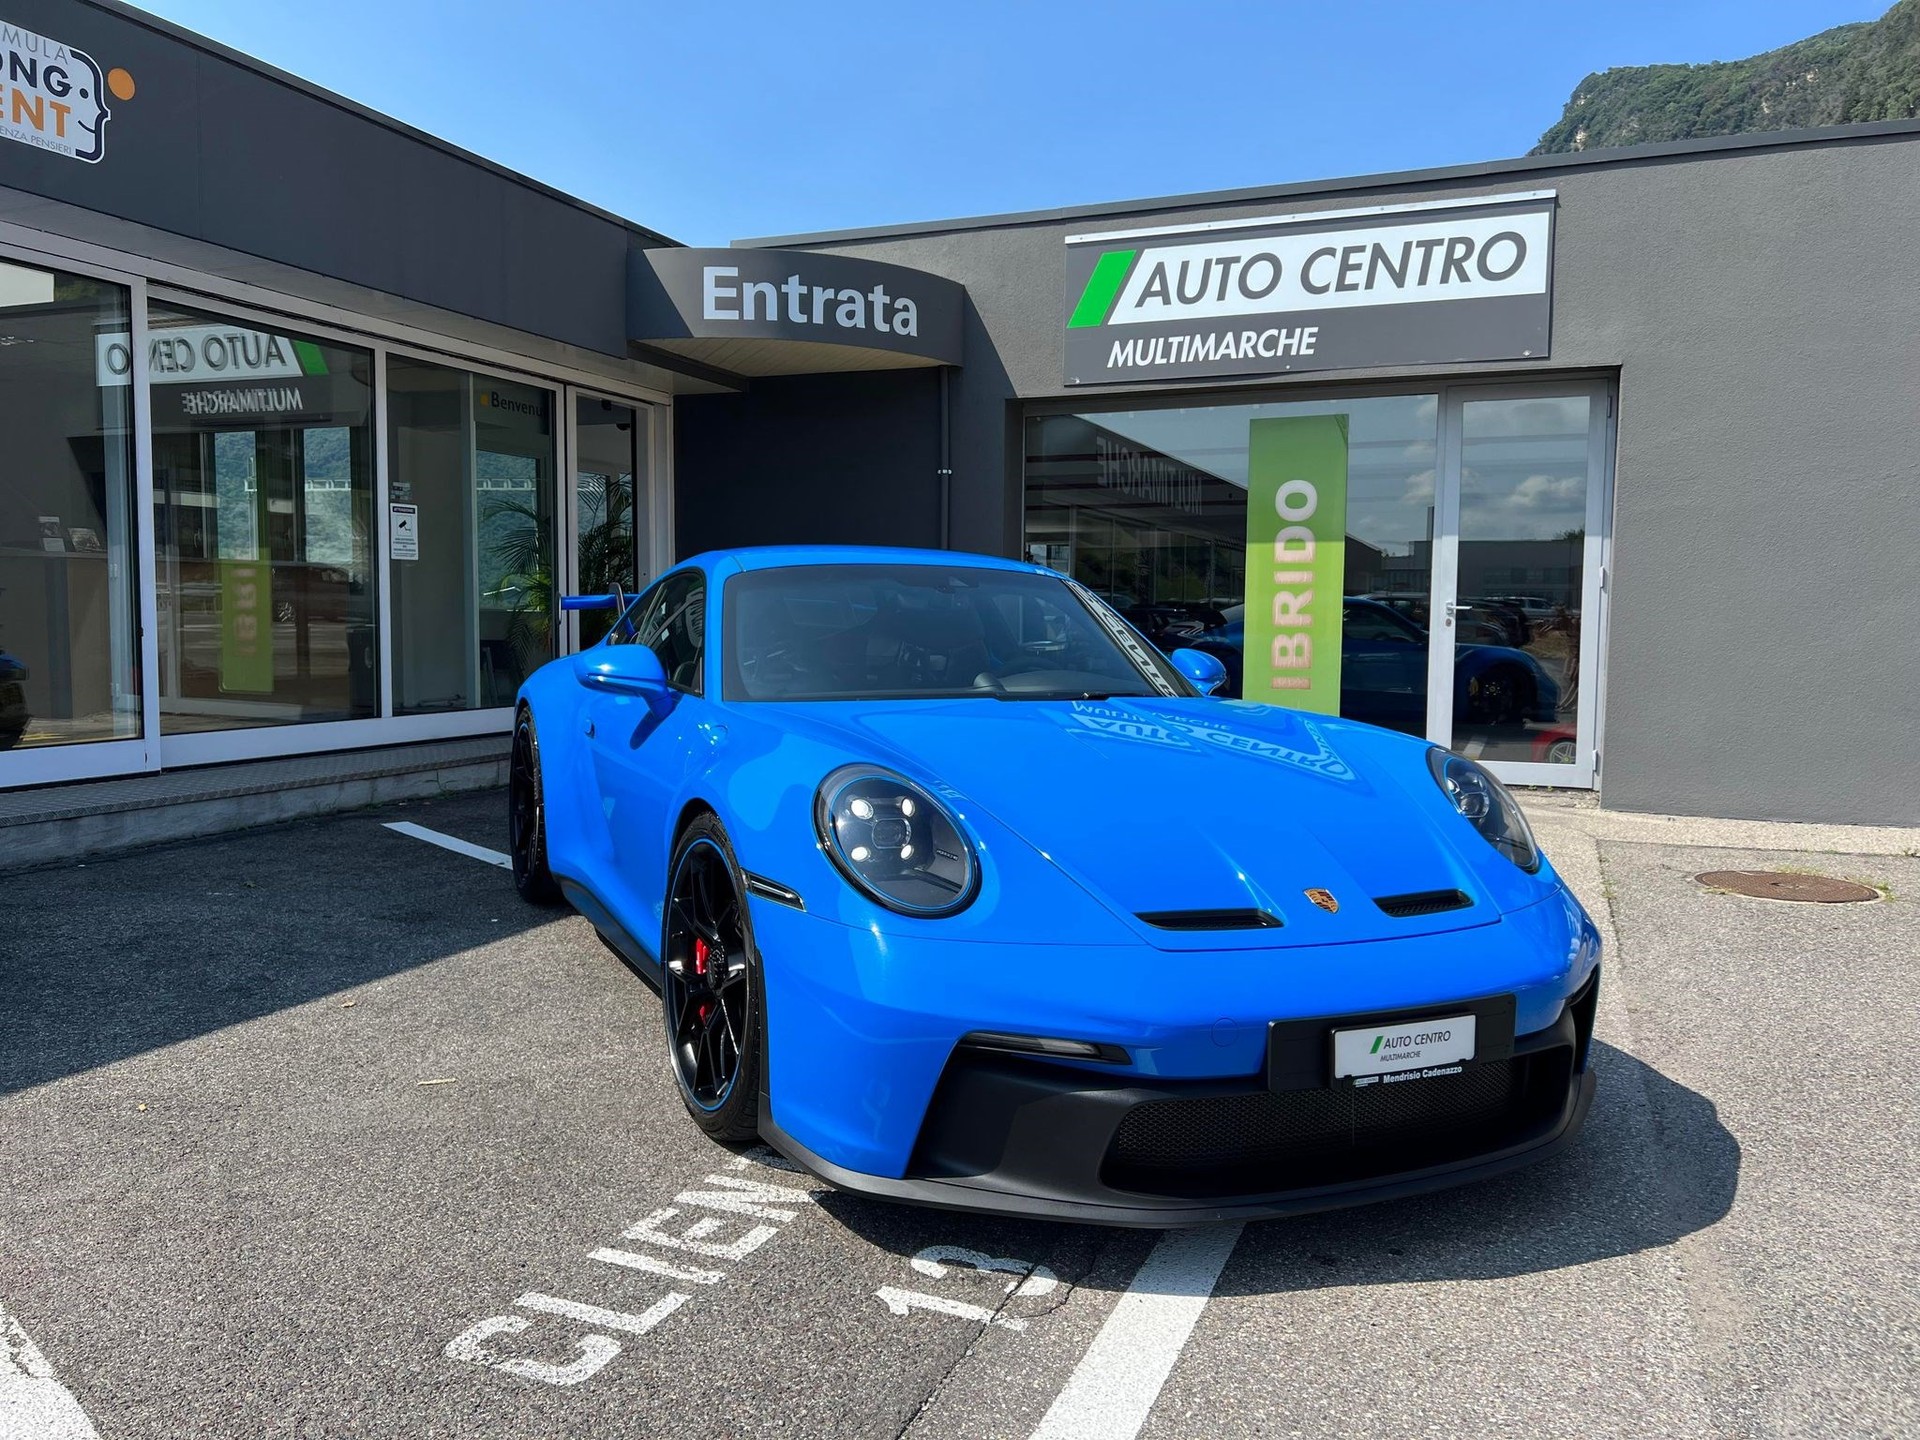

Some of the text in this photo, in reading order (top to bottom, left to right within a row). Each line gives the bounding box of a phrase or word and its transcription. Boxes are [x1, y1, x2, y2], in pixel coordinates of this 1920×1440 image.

[0, 50, 72, 98] NG
[0, 84, 71, 138] NT
[31, 135, 71, 155] PENSIERI
[1134, 231, 1528, 309] AUTO CENTRO
[703, 266, 918, 337] Entrata
[1107, 327, 1319, 368] MULTIMARCHE
[1271, 479, 1318, 690] IBRIDO
[1380, 1051, 1421, 1062] MULTIMARCHE
[1383, 1030, 1451, 1050] AUTO CENTRO
[1383, 1070, 1420, 1084] Mendrisio
[1422, 1065, 1463, 1078] Cadenazzo
[875, 1244, 1059, 1332] 13
